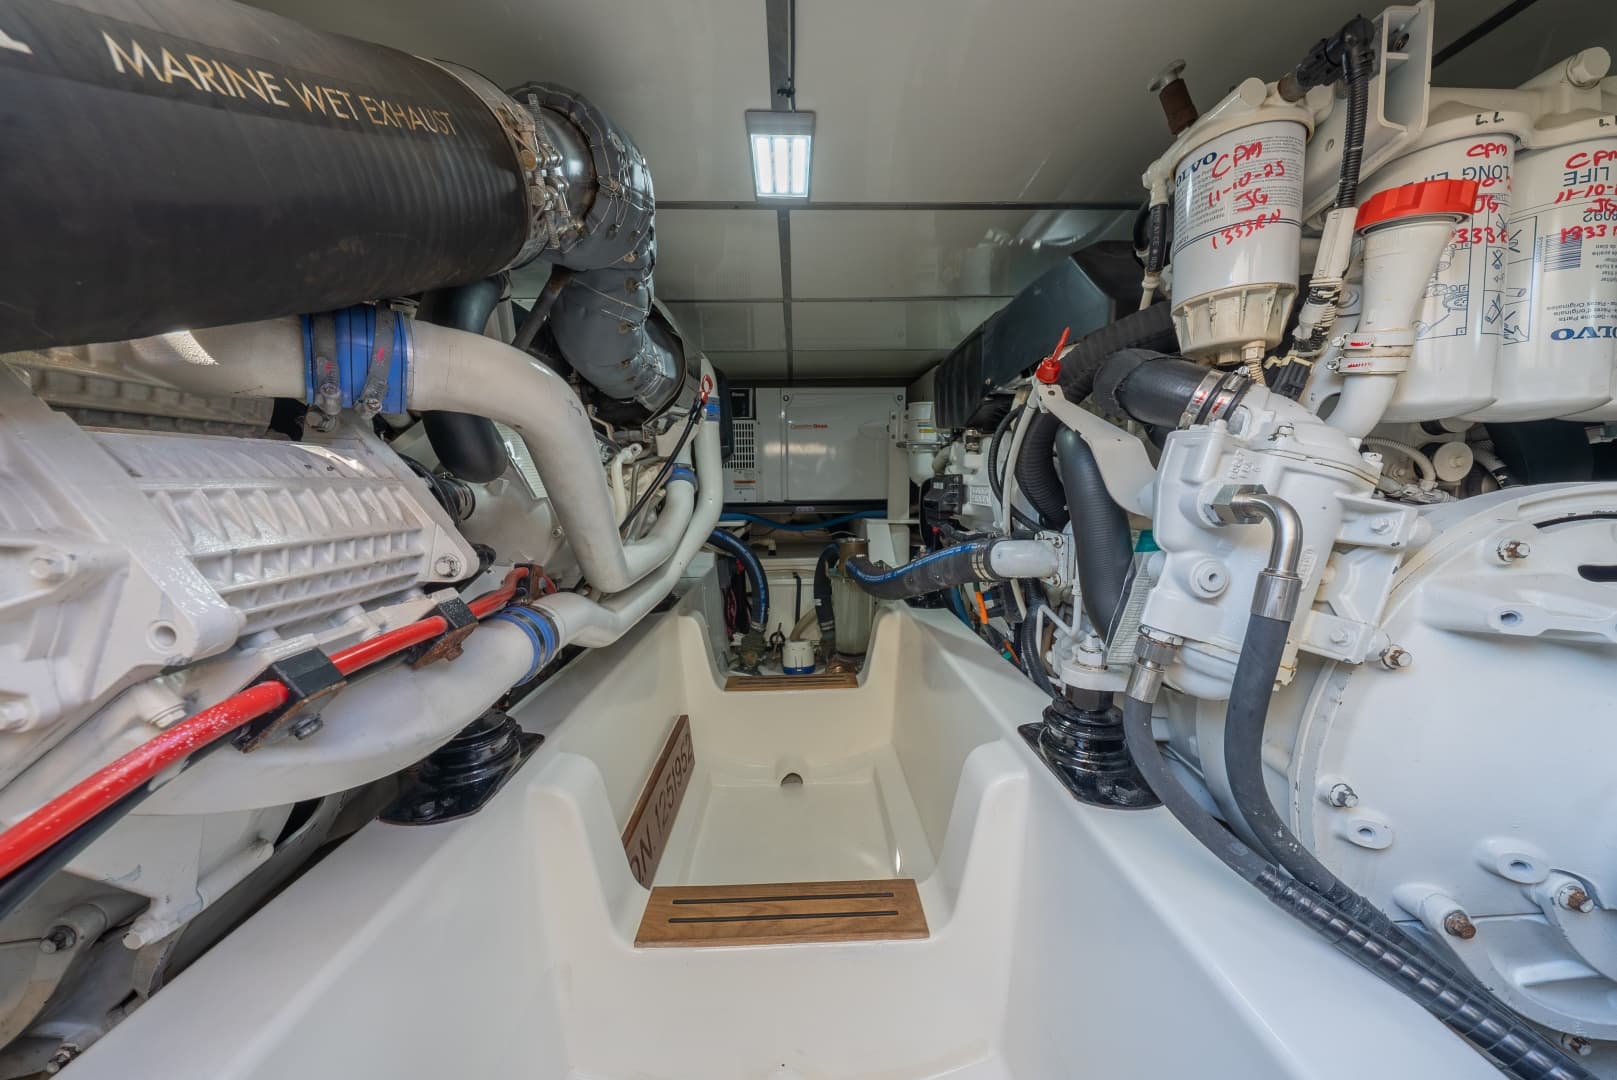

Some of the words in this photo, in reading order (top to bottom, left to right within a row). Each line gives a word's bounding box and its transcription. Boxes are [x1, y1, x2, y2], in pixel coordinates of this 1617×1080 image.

[101, 30, 290, 107] MARINE
[284, 77, 359, 121] WET
[358, 95, 457, 136] EXHAUST
[1212, 141, 1263, 178] CPM
[1466, 142, 1508, 158] CPM
[1208, 160, 1285, 208] 11-10-25
[1462, 164, 1510, 184] LONG
[1563, 166, 1609, 187] LIFE
[1554, 183, 1617, 205] 11-10-
[1551, 325, 1617, 341] LVO
